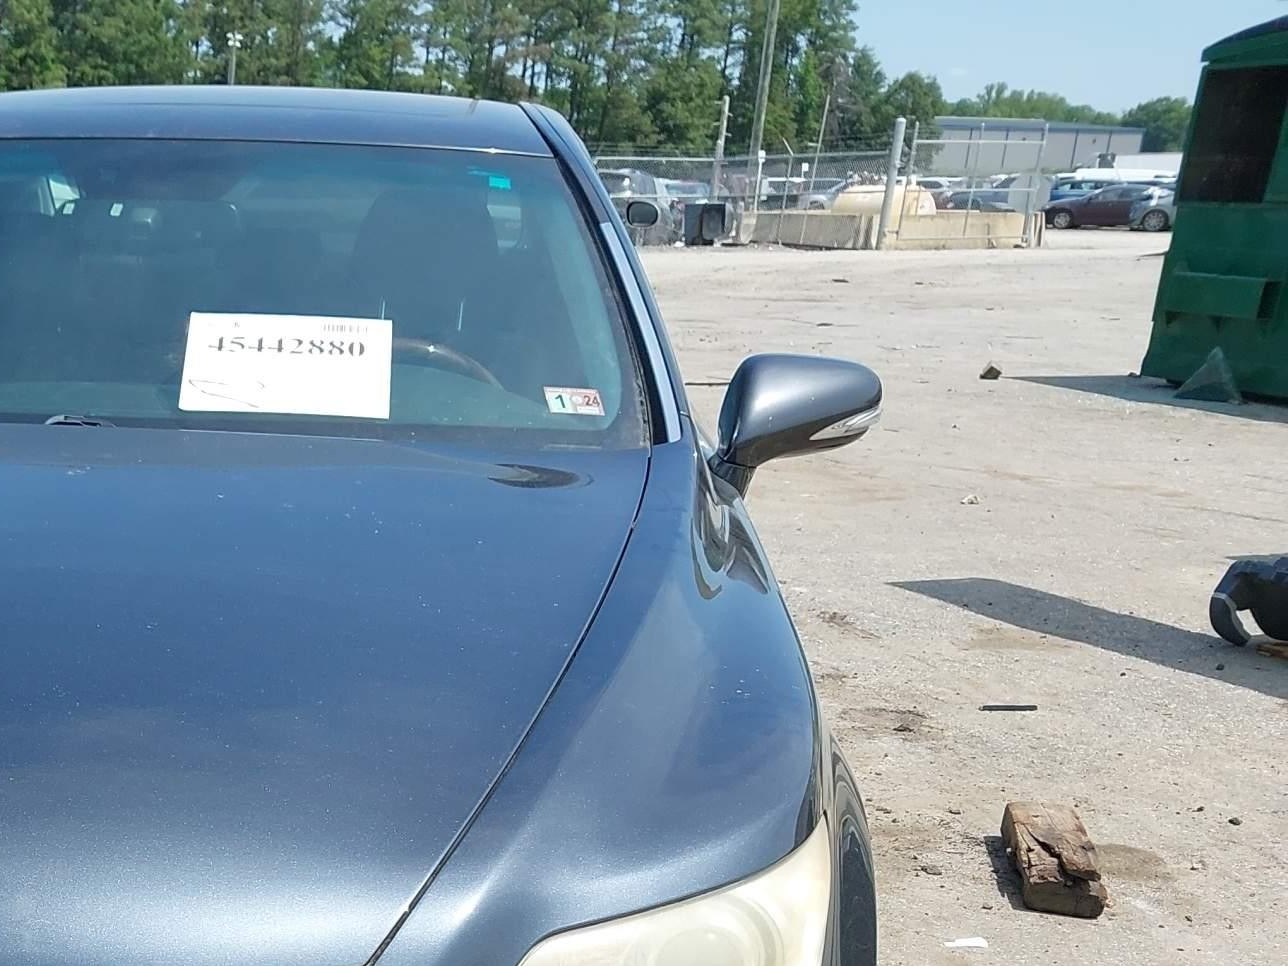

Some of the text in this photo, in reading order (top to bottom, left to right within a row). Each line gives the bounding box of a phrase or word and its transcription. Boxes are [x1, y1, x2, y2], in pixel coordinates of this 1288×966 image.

[208, 335, 365, 357] 45442880
[554, 394, 601, 409] 1 24
